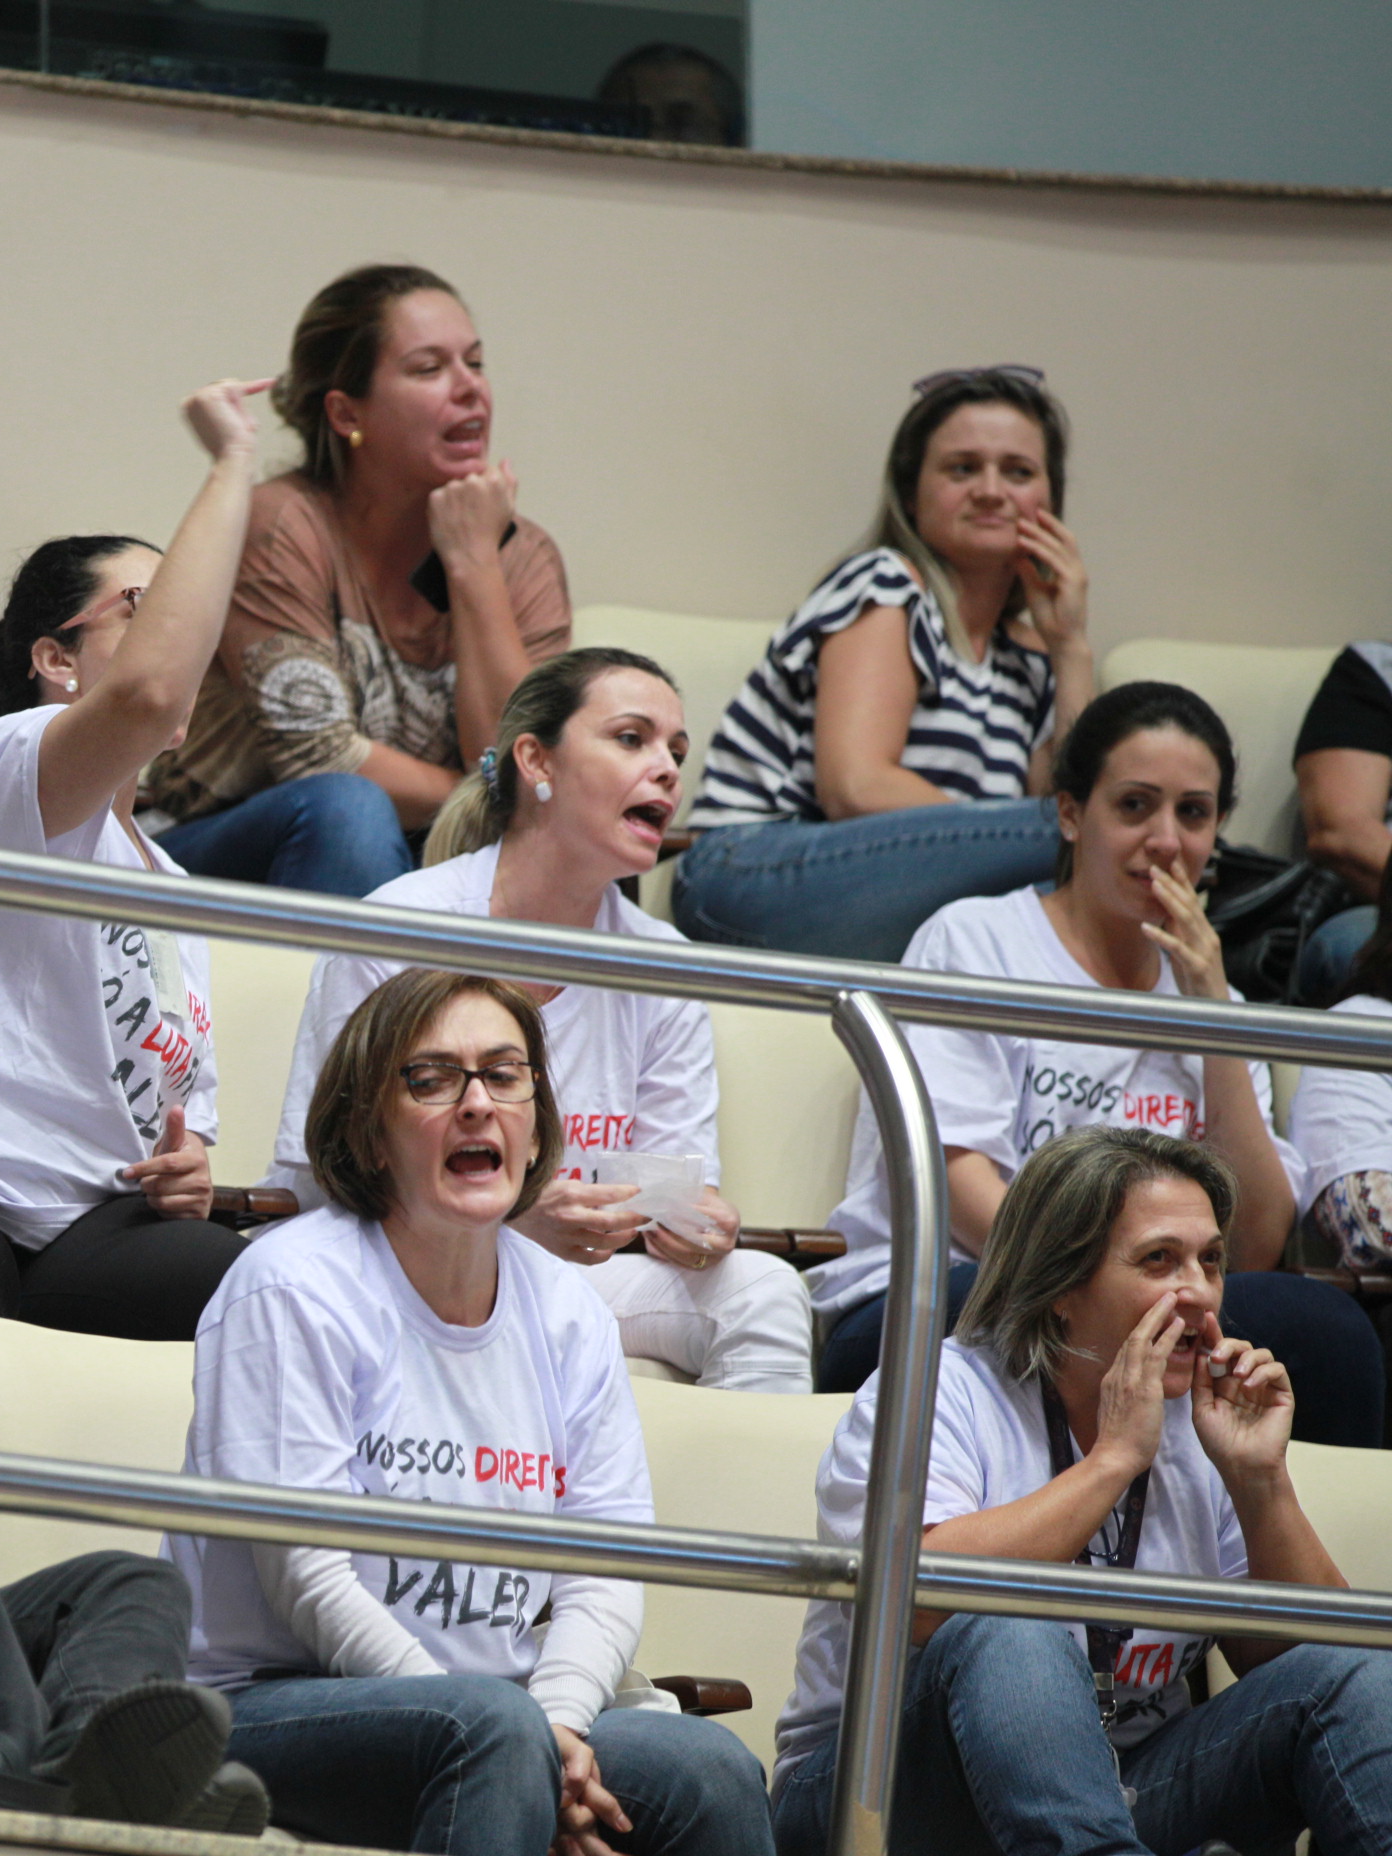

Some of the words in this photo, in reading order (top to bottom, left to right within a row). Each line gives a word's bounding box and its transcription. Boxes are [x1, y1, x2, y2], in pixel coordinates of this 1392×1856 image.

[1022, 1064, 1121, 1114] NOSSOS
[357, 1430, 466, 1479] NOSSOS
[383, 1556, 530, 1638] VALER
[1113, 1642, 1175, 1689] UTA
